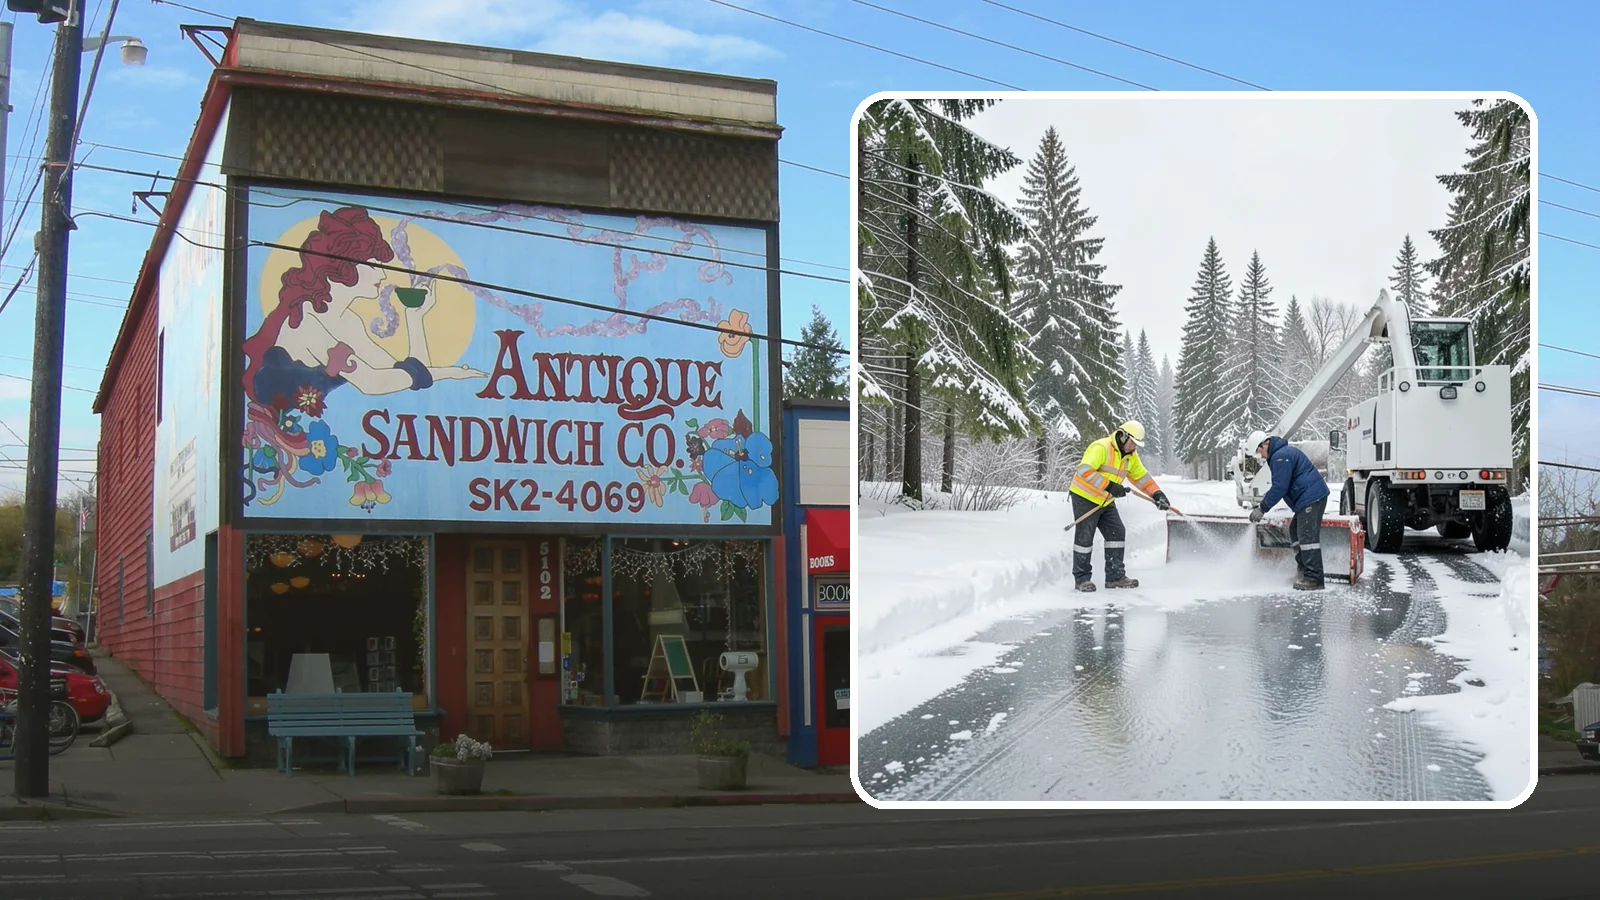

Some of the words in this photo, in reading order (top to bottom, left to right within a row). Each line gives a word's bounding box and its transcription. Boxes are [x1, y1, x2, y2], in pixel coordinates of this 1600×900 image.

[360, 408, 603, 466] SANDWICH
[616, 422, 686, 469] CO.
[468, 476, 646, 511] SK2-4069
[539, 541, 551, 600] 5102
[809, 555, 835, 569] BOOKS
